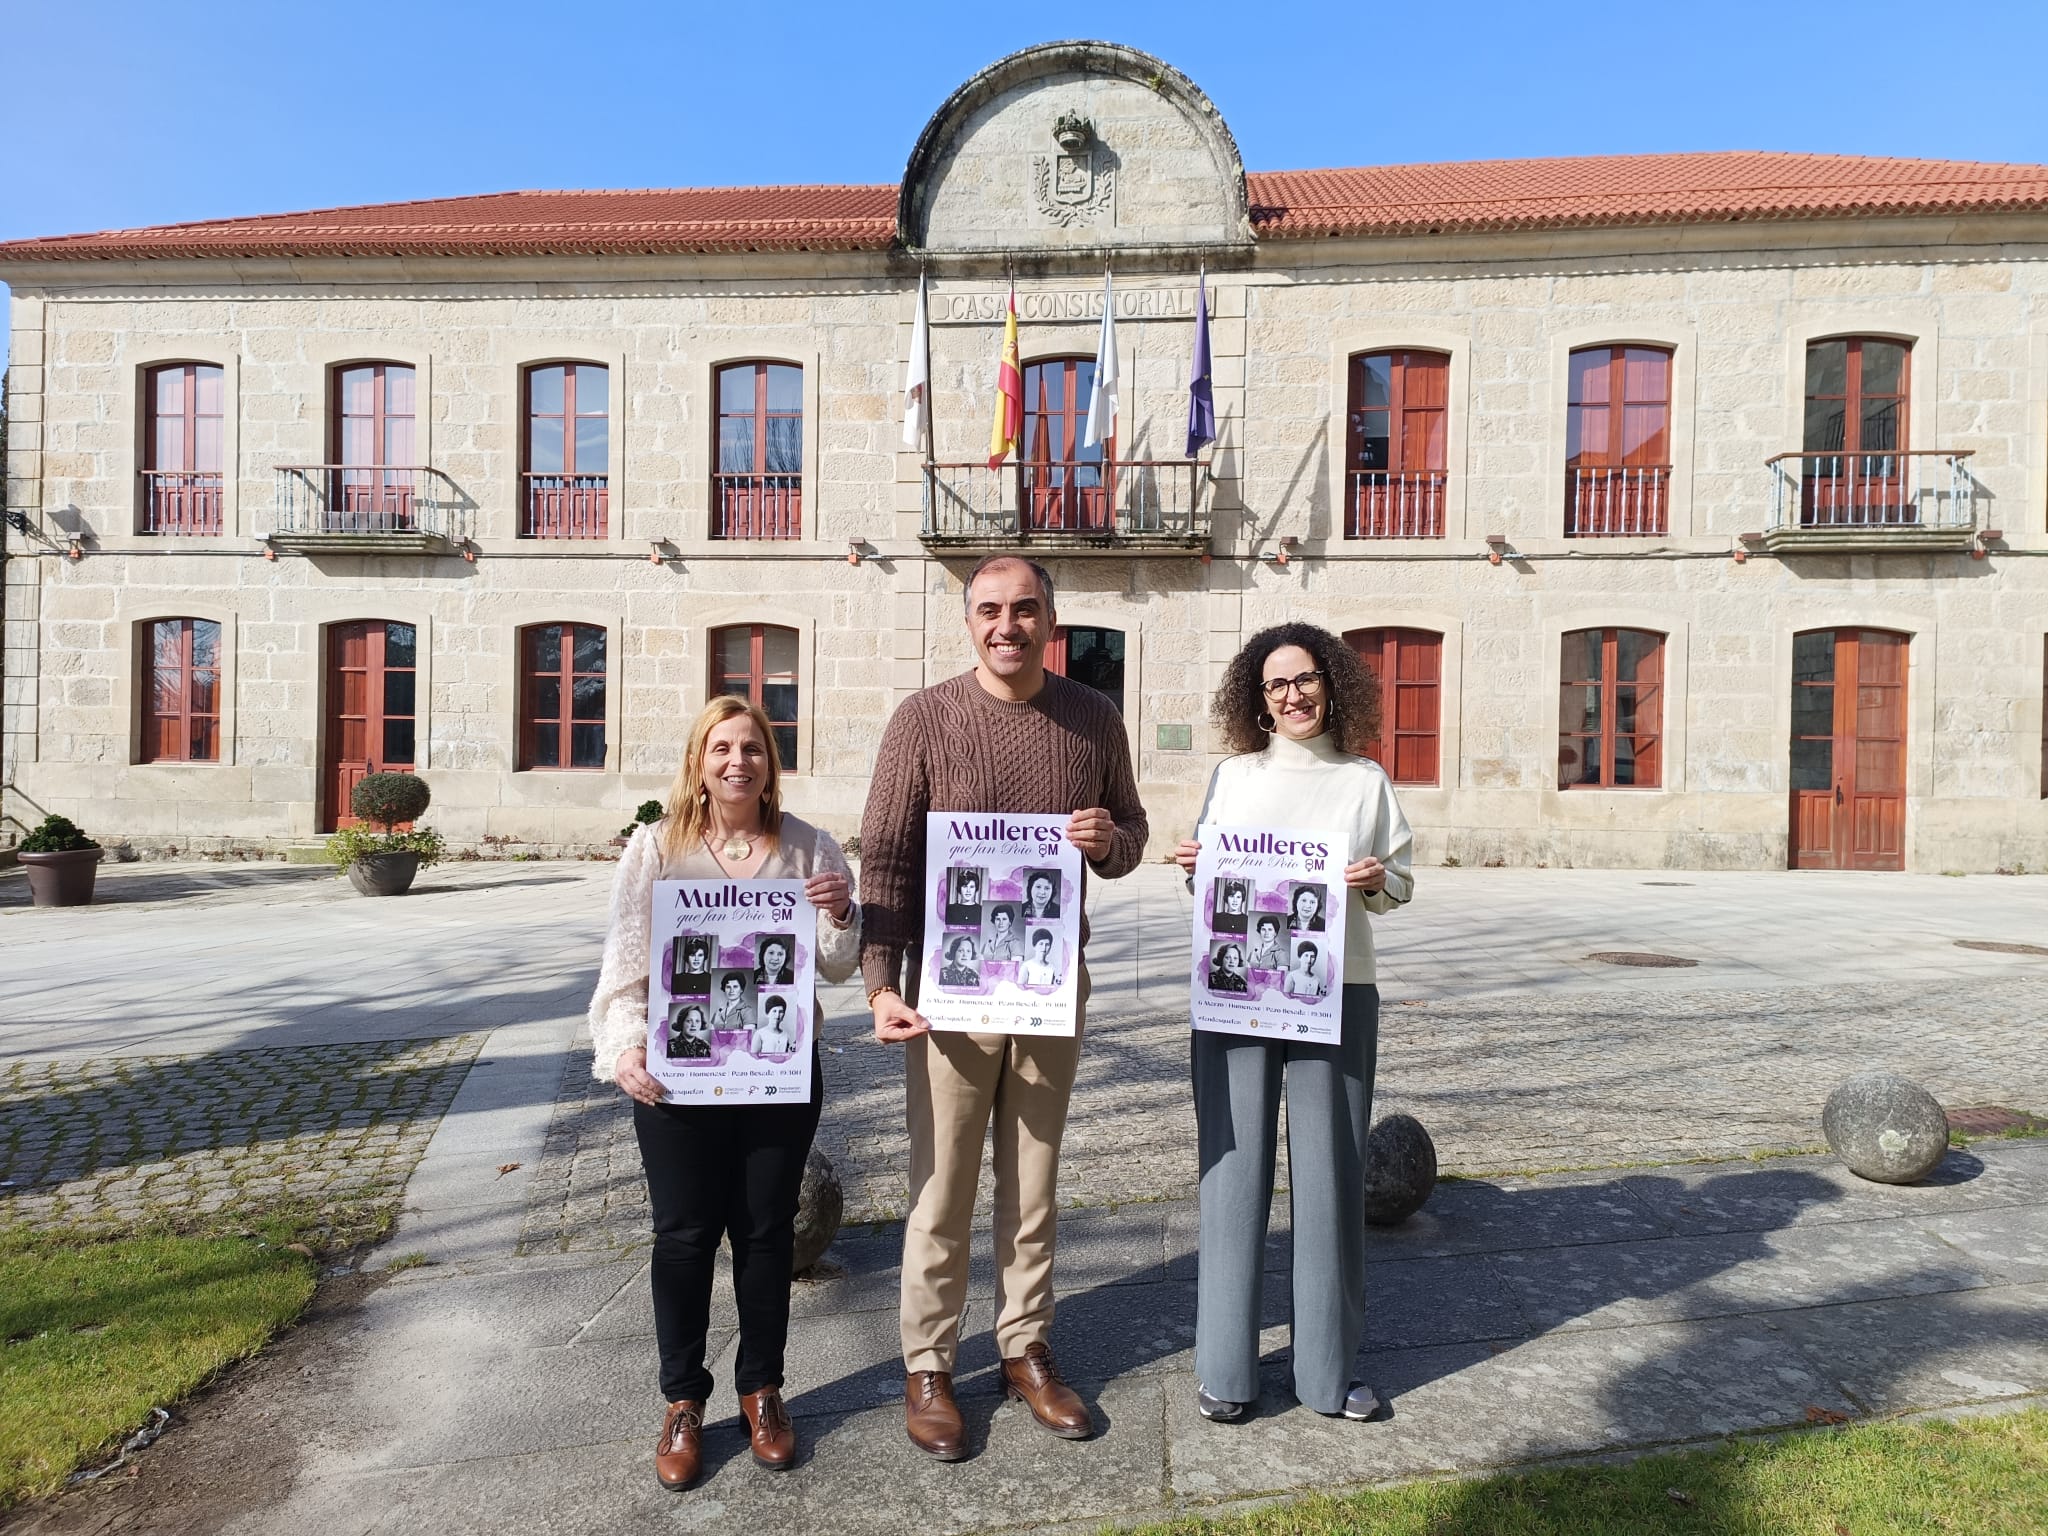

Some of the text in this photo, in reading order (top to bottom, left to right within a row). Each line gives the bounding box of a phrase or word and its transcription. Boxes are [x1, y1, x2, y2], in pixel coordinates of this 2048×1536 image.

[952, 290, 1192, 320] CASA CONSISTORIAL
[947, 819, 1063, 842] Mulleres
[948, 845, 972, 860] que
[971, 841, 996, 858] fan
[1000, 842, 1032, 855] Poio
[1216, 833, 1329, 858] Mulleres
[1217, 856, 1240, 870] que
[1239, 854, 1263, 869] fan
[1267, 855, 1298, 868] Poio
[674, 885, 797, 909] Mulleres
[676, 913, 701, 929] que
[698, 909, 727, 927] fan
[731, 909, 765, 921] Poio
